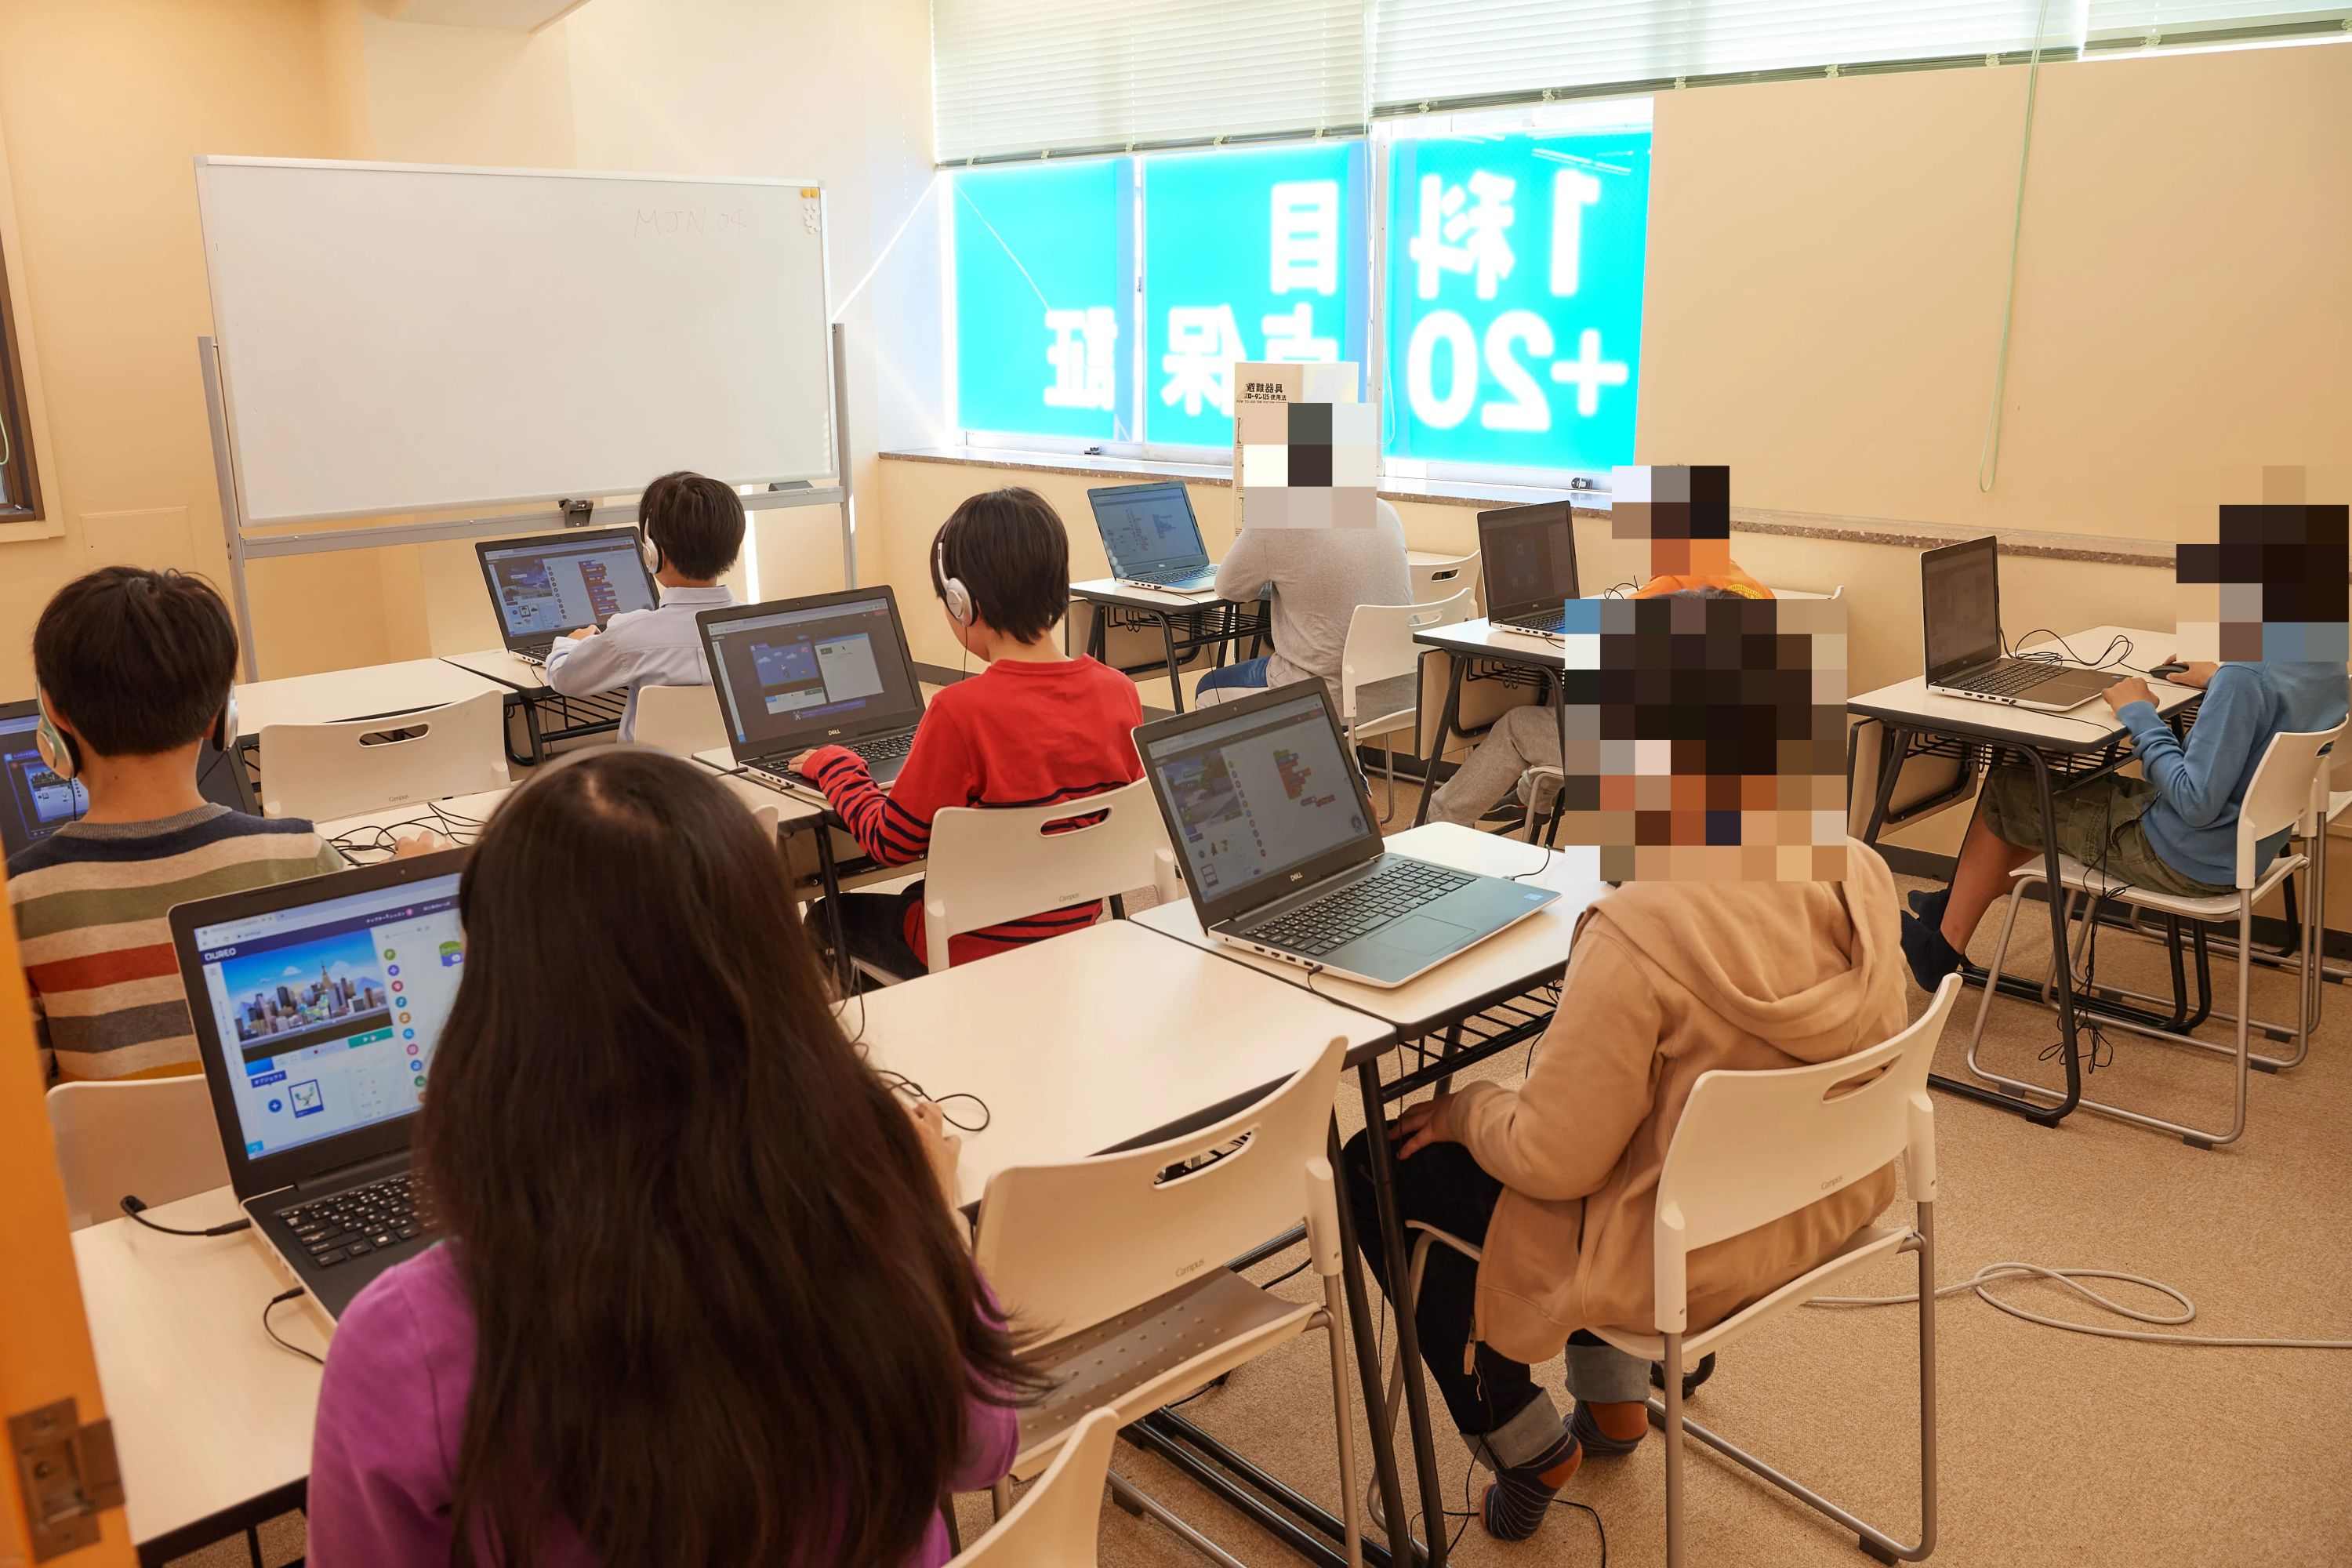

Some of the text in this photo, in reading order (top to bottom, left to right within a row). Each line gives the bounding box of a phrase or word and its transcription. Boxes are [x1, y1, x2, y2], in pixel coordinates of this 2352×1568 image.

[634, 207, 706, 238] MJN
[1246, 383, 1283, 393] 避難器具
[1290, 871, 1304, 881] DELL
